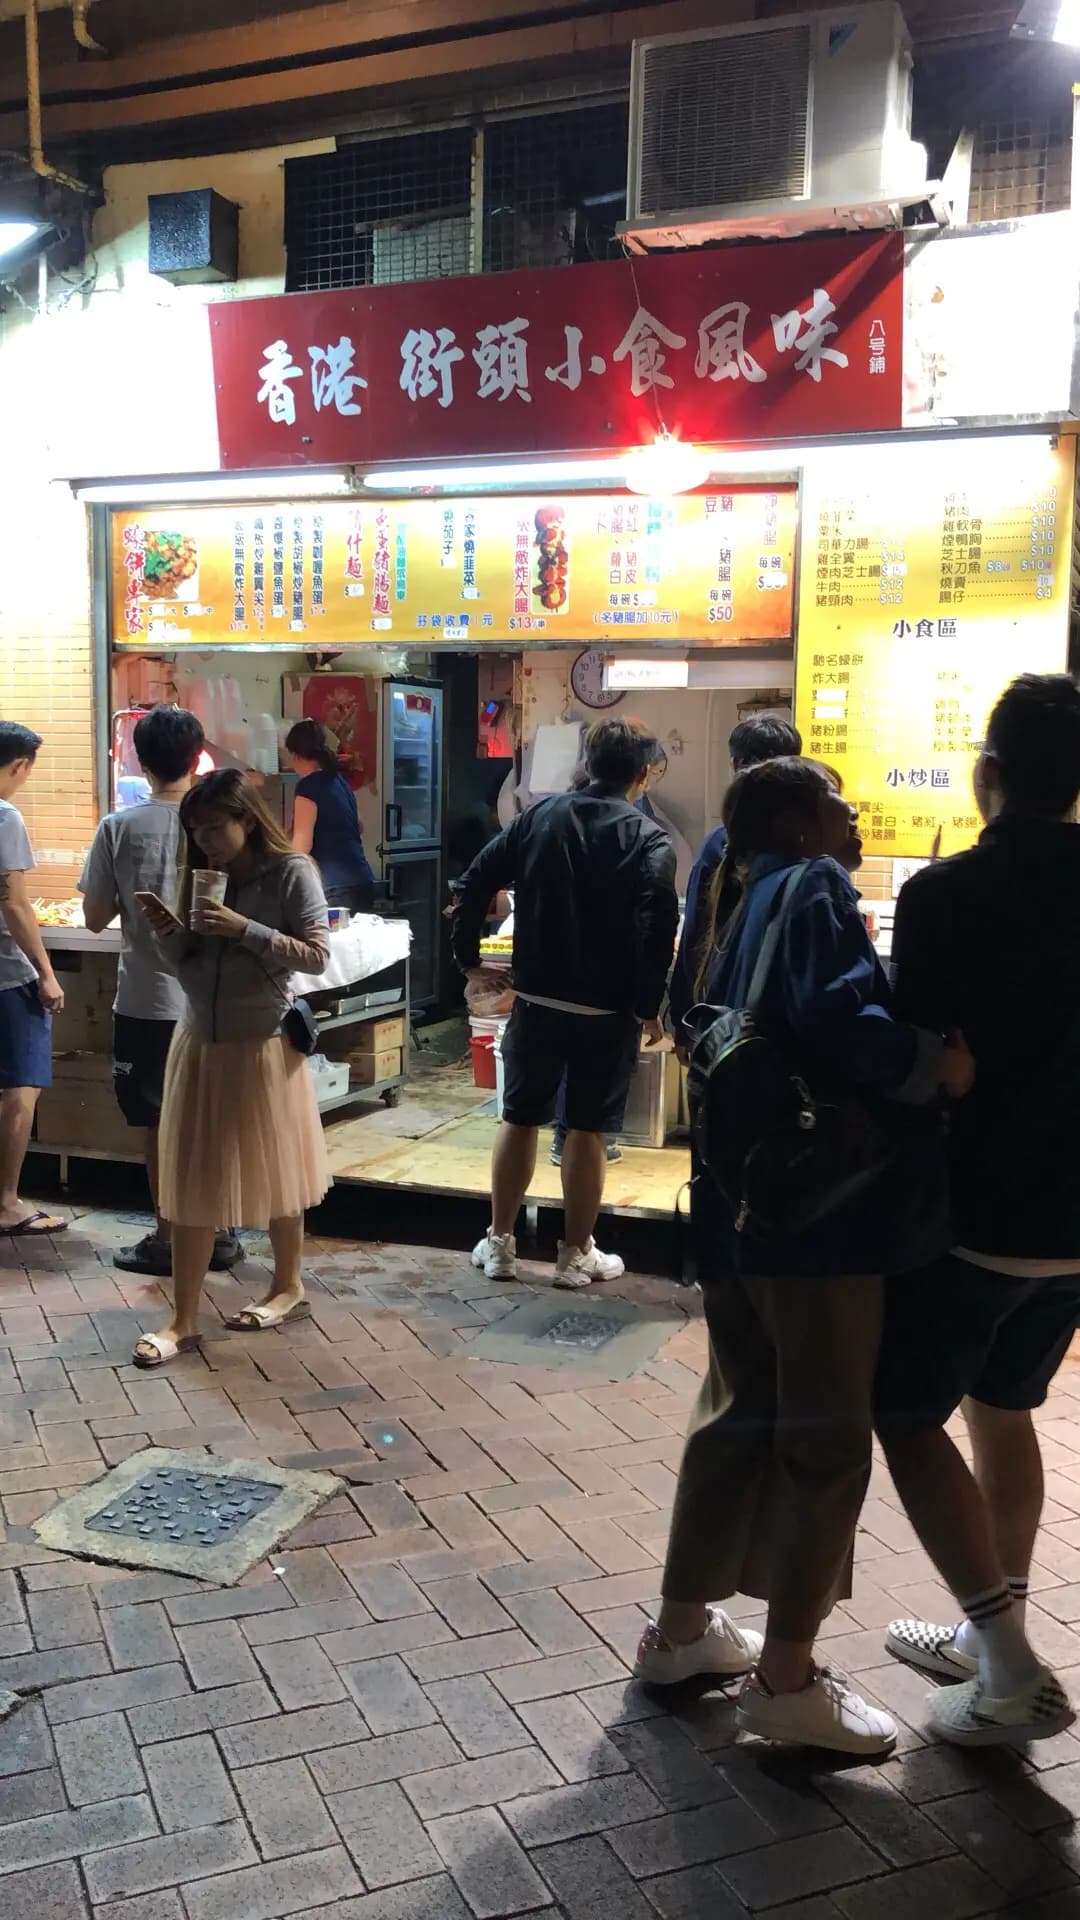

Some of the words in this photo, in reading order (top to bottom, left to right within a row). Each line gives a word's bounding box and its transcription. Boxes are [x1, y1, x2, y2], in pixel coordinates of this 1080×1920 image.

[257, 336, 368, 426] 香港
[399, 288, 849, 408] 街頭小食風味
[1031, 515, 1055, 528] $10
[1031, 530, 1055, 543] $10
[1030, 545, 1054, 557] $10
[940, 561, 981, 576] 秋刀魚
[816, 581, 840, 593] 牛肉
[939, 576, 966, 589] 燒賣
[939, 591, 965, 604] 腸仔
[709, 606, 732, 620] $50
[893, 618, 957, 639] 小食區
[812, 671, 850, 684] 炸大腸
[811, 724, 848, 737] 豬粉腸
[810, 742, 847, 754] 豬生腸
[886, 768, 950, 788] 小炒區
